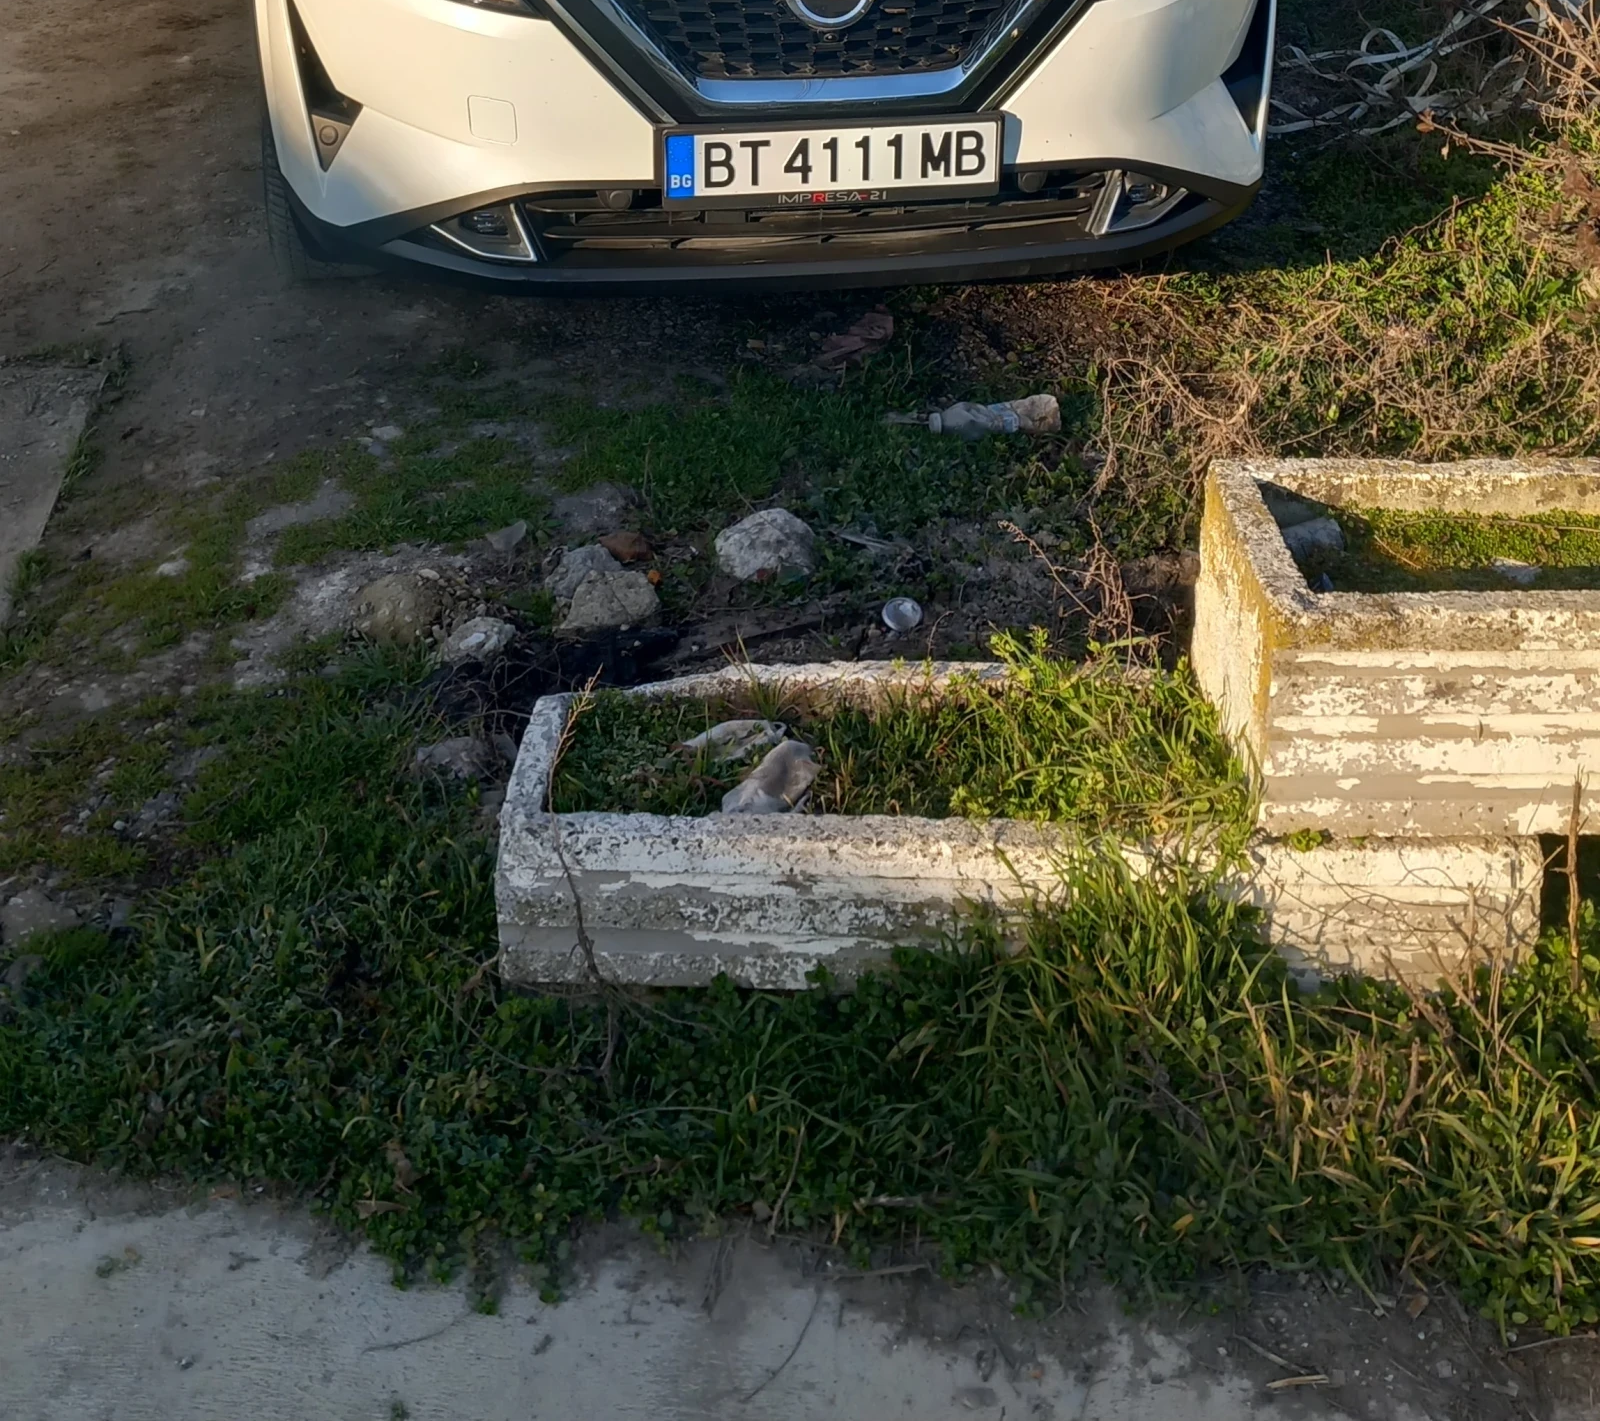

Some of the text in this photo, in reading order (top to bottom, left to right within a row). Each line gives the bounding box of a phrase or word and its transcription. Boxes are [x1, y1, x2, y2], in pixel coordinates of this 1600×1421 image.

[703, 130, 986, 189] BT 4111 MB
[669, 174, 692, 189] BG
